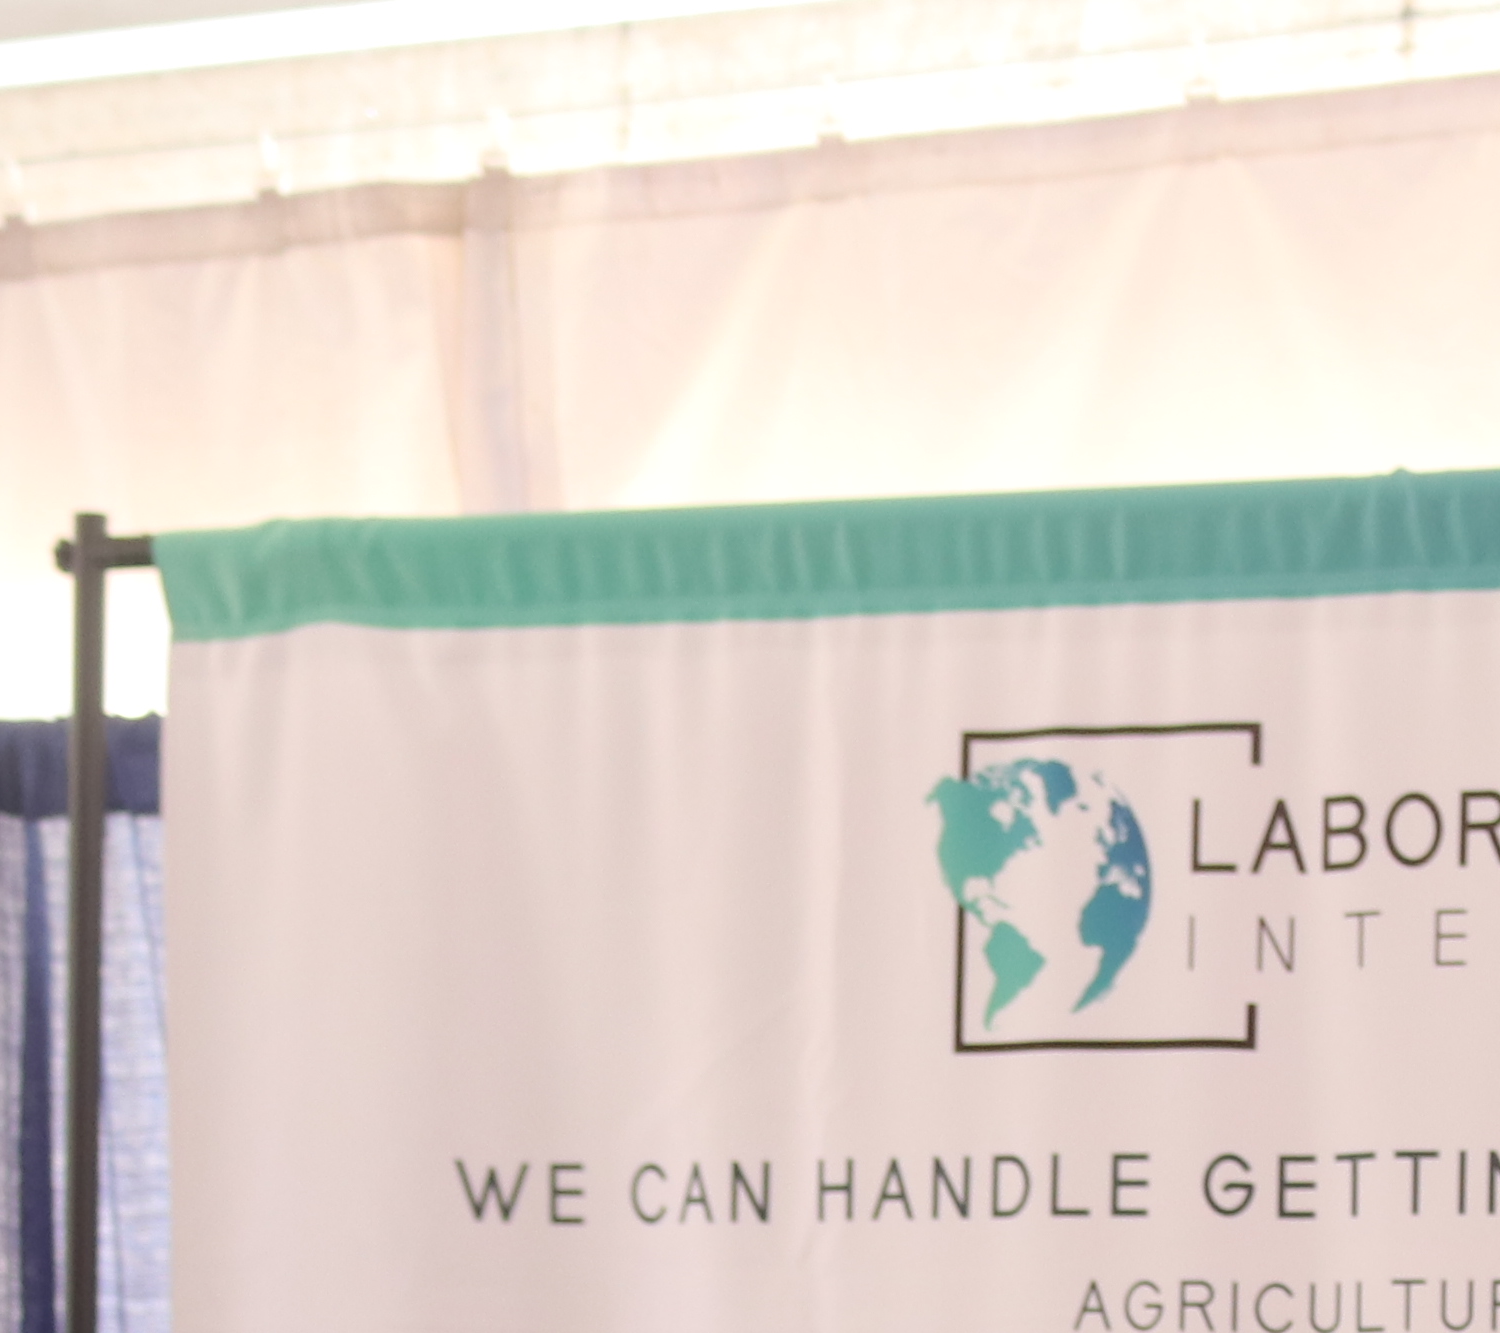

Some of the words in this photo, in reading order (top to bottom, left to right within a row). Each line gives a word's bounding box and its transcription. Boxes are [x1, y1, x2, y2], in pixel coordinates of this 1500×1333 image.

[453, 1158, 585, 1227] WE
[630, 1160, 772, 1226] CAN
[817, 1152, 1151, 1222] HANDLE
